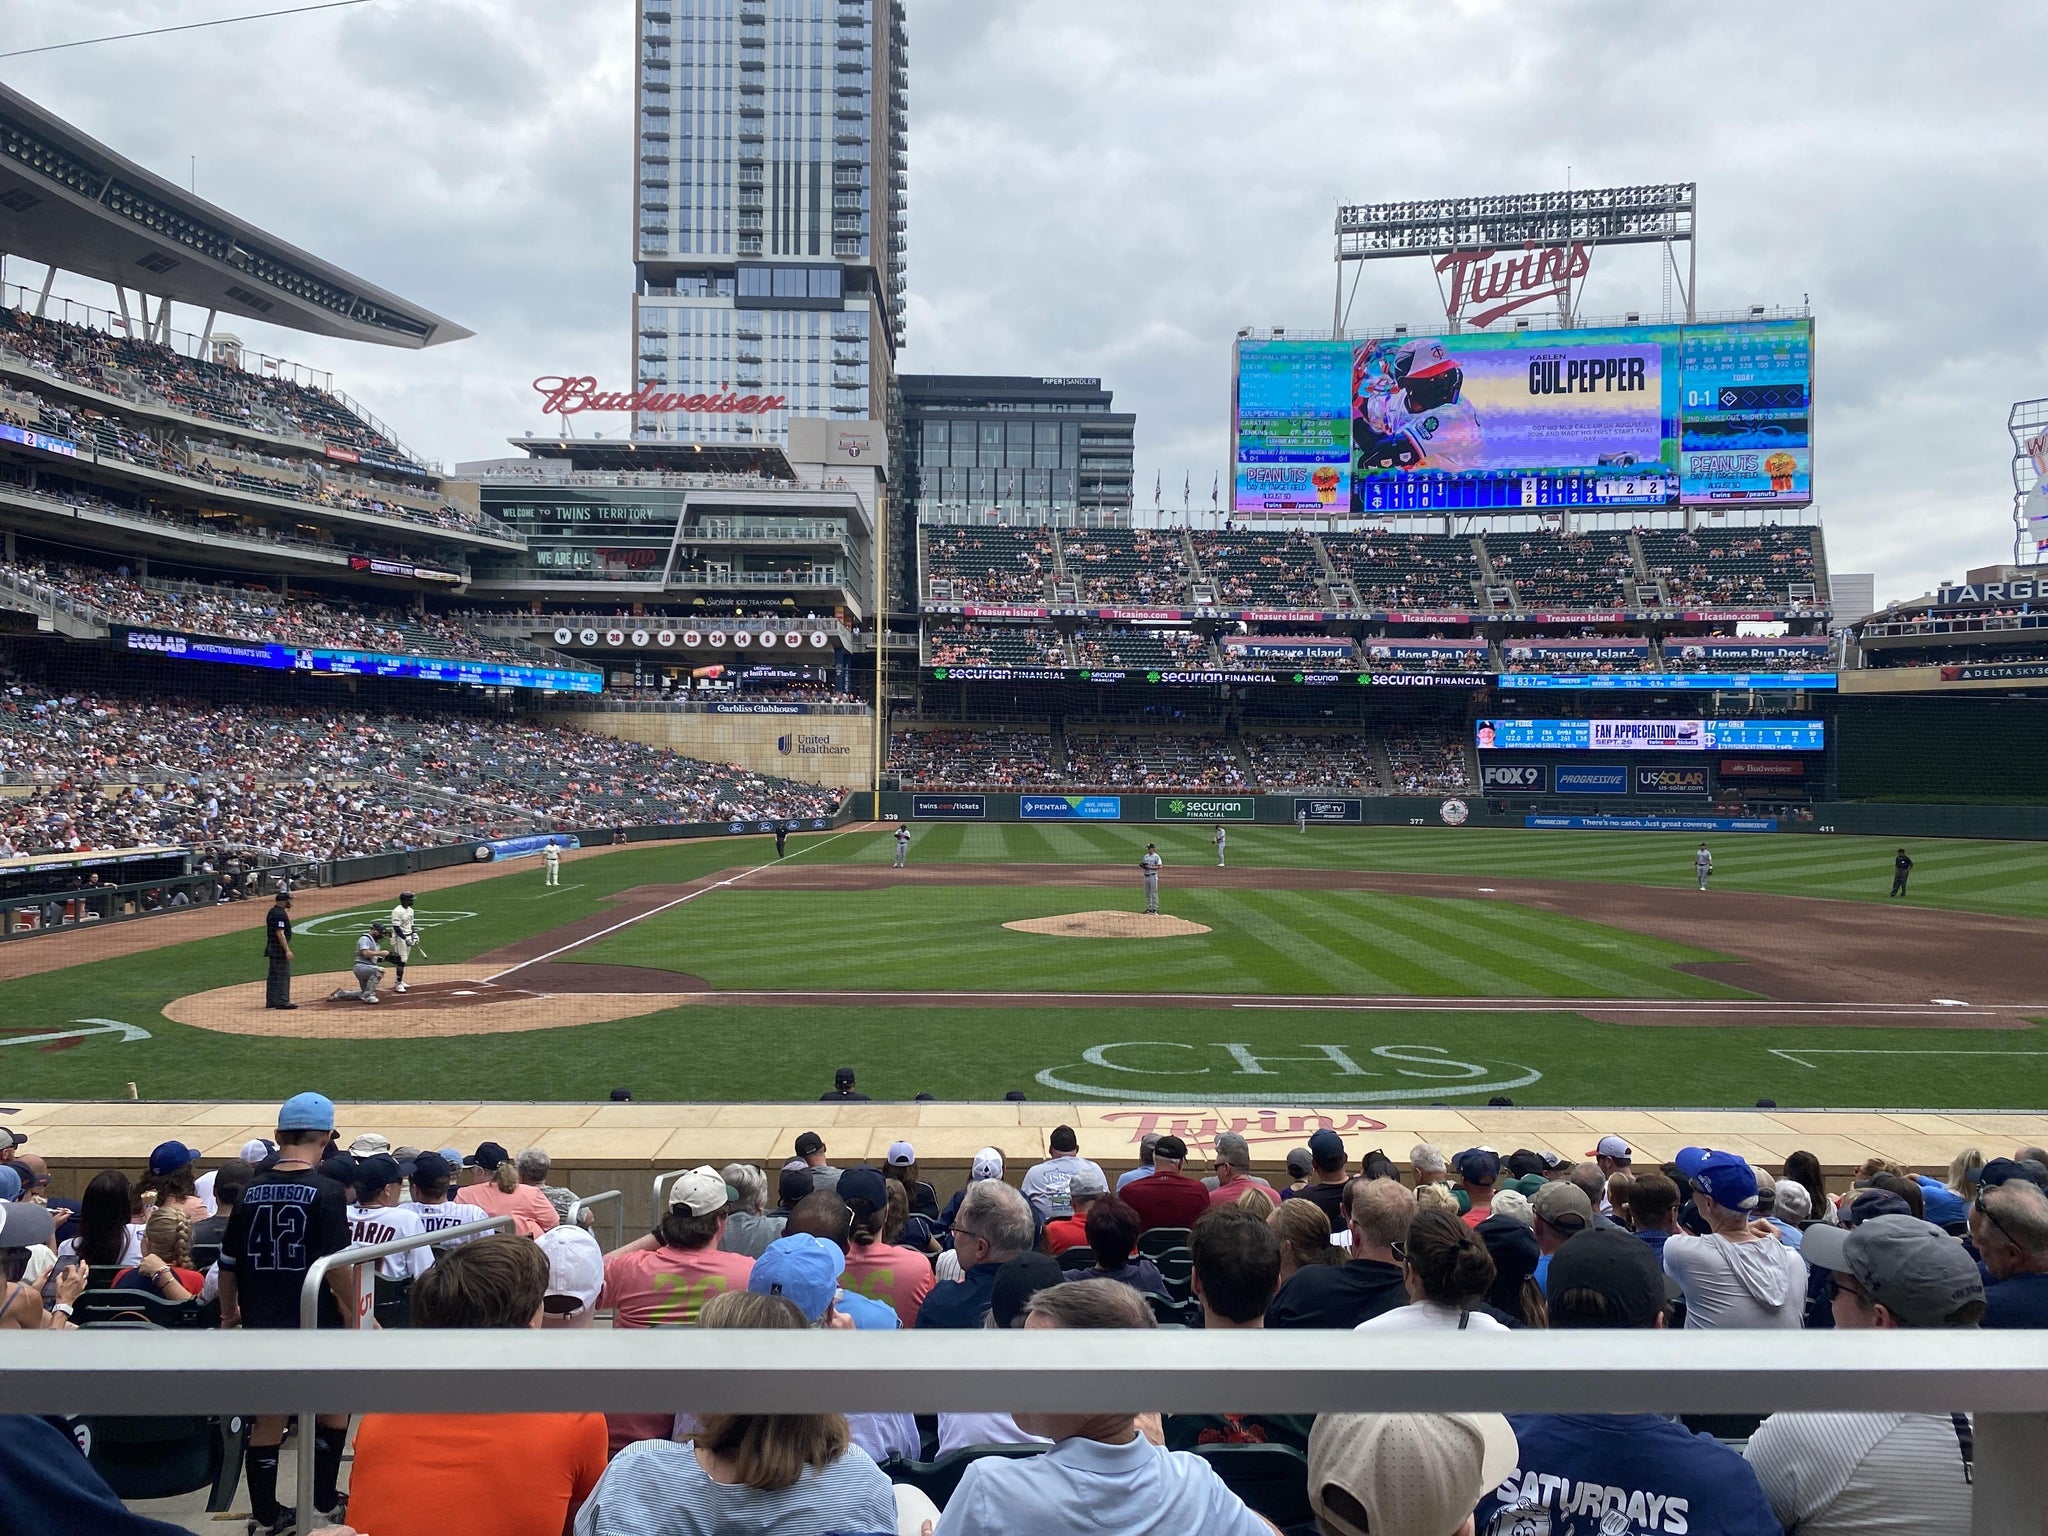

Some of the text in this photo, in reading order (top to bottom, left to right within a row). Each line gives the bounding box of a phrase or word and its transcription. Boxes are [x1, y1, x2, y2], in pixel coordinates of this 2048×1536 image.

[1436, 240, 1590, 322] Twins
[1529, 353, 1566, 361] KAELEN
[1529, 357, 1646, 395] CULPEPPER
[532, 375, 786, 415] Budweiser
[1688, 390, 1710, 406] 0-1
[1690, 455, 1759, 473] PEANUTS
[1247, 467, 1307, 483] PEANUTS
[1626, 482, 1634, 494] 2
[1650, 482, 1657, 493] 2
[502, 508, 535, 518] WELCOME
[556, 507, 591, 520] TWINS
[598, 507, 653, 520] TERRITORY
[537, 551, 551, 564] WE
[554, 551, 572, 565] ARE
[573, 551, 591, 565] ALL
[974, 608, 1039, 617] Treasure Island
[1250, 612, 1314, 621] Treasure Island
[1546, 614, 1616, 623] Treasure Island
[559, 632, 567, 640] W
[584, 633, 594, 641] 42
[610, 633, 620, 642] 36
[662, 634, 671, 642] 10
[711, 635, 723, 643] 34
[738, 635, 747, 643] 14
[127, 631, 187, 653] ECOLAB
[193, 643, 232, 655] PROTECTING
[1253, 647, 1342, 658] Treasure Island
[1397, 650, 1430, 659] Home
[1538, 649, 1593, 659] Treasure
[1712, 648, 1809, 659] Home Run Deck
[295, 660, 313, 669] MLB
[948, 668, 1065, 680] securian FINANCIAL
[1161, 671, 1276, 682] securian FINANCIAL
[1974, 669, 2012, 677] DELTA
[1371, 674, 1487, 685] securian FINANCIAL
[1517, 677, 1537, 686] 83.7
[717, 704, 799, 713] Carbliss Clubhouse
[1707, 720, 1717, 730] 17
[1595, 724, 1676, 738] FAN APPRECIATION
[797, 734, 830, 744] United
[797, 744, 850, 754] Healthcare
[1746, 764, 1792, 773] Budweiser
[1485, 767, 1538, 784] FOX 9
[1560, 774, 1624, 784] PROGRESSIVE
[1034, 803, 1067, 811] PENTAIR
[1186, 801, 1241, 811] securian
[1621, 819, 1642, 827] catch.
[1661, 820, 1681, 828] great
[1082, 1041, 1488, 1078] CHS
[1100, 1110, 1387, 1145] Twins
[243, 1183, 318, 1204] ROBINSON
[247, 1204, 307, 1271] 42
[360, 1292, 372, 1317] 5
[1496, 1467, 1689, 1535] SATURDAYS
